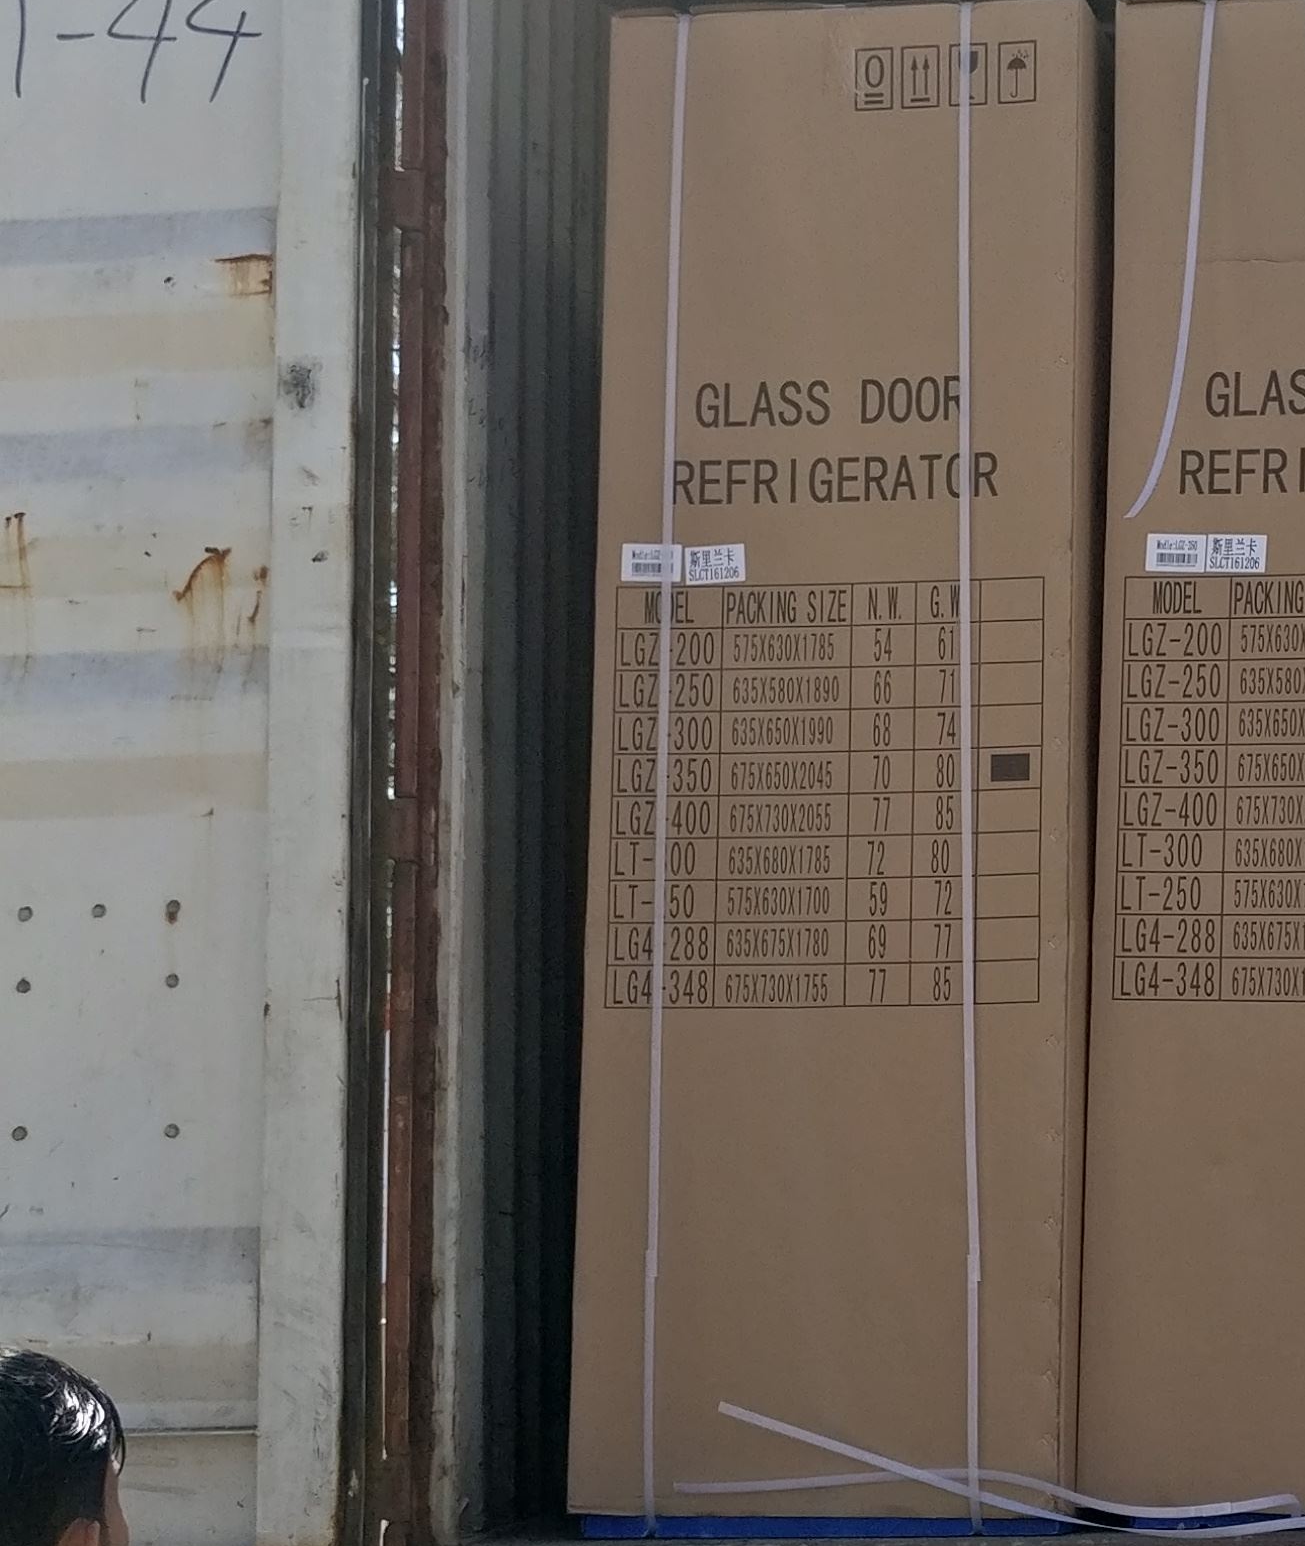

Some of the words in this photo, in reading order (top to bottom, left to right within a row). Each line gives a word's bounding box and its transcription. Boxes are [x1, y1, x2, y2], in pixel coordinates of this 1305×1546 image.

[696, 379, 831, 428] GLASS
[860, 375, 960, 424] DOOR
[673, 451, 998, 505] REFRIGERATOR
[1209, 556, 1260, 570] SLCT161206
[644, 591, 695, 624] MOEL
[726, 591, 798, 624] PACKING
[807, 590, 847, 622] SIZE
[1153, 581, 1202, 614] MODEL
[1234, 580, 1304, 614] PACKING
[620, 632, 715, 667] LGZ200
[734, 634, 834, 661] 575X630X1785
[874, 627, 893, 662] 54
[938, 626, 954, 661] 61
[1128, 622, 1222, 656] LGZ-200
[619, 673, 714, 707] LGZ250
[733, 676, 839, 704] 635X580X1890
[873, 670, 892, 705] 66
[939, 671, 955, 703] 71
[1126, 664, 1221, 698] LGZ-250
[618, 716, 713, 751] LGZ300
[732, 718, 833, 746] 635X650X1990
[873, 713, 891, 747] 68
[938, 712, 955, 745] 74
[1126, 707, 1220, 742] LGZ-300
[616, 759, 712, 793] LGZ350
[731, 760, 832, 790] 675X650X2045
[873, 756, 890, 789] 70
[937, 753, 955, 786] 80
[1124, 749, 1218, 784] LGZ-350
[615, 800, 711, 836] LGZ400
[730, 803, 831, 832] 675X730X2055
[873, 797, 890, 831] 77
[936, 796, 954, 829] 85
[1123, 792, 1217, 827] LGZ-400
[615, 841, 696, 876] LT-00
[728, 845, 831, 875] 635X680X1785
[868, 842, 885, 875] 72
[931, 840, 950, 873] 80
[1122, 833, 1201, 867] LT-300
[614, 885, 694, 920] LT-50
[727, 887, 830, 915] 575X630X1700
[869, 883, 888, 916] 59
[934, 881, 952, 915] 72
[1121, 876, 1200, 910] LT-250
[614, 926, 709, 962] LG4288
[726, 928, 829, 957] 635X675X1780
[868, 925, 886, 958] 69
[934, 925, 952, 958] 77
[1121, 918, 1215, 953] LG4-288
[613, 970, 708, 1005] LG4348
[726, 974, 828, 1002] 675X730X1755
[869, 969, 886, 1002] 77
[933, 967, 951, 1001] 85
[1120, 961, 1215, 996] LG4-348
